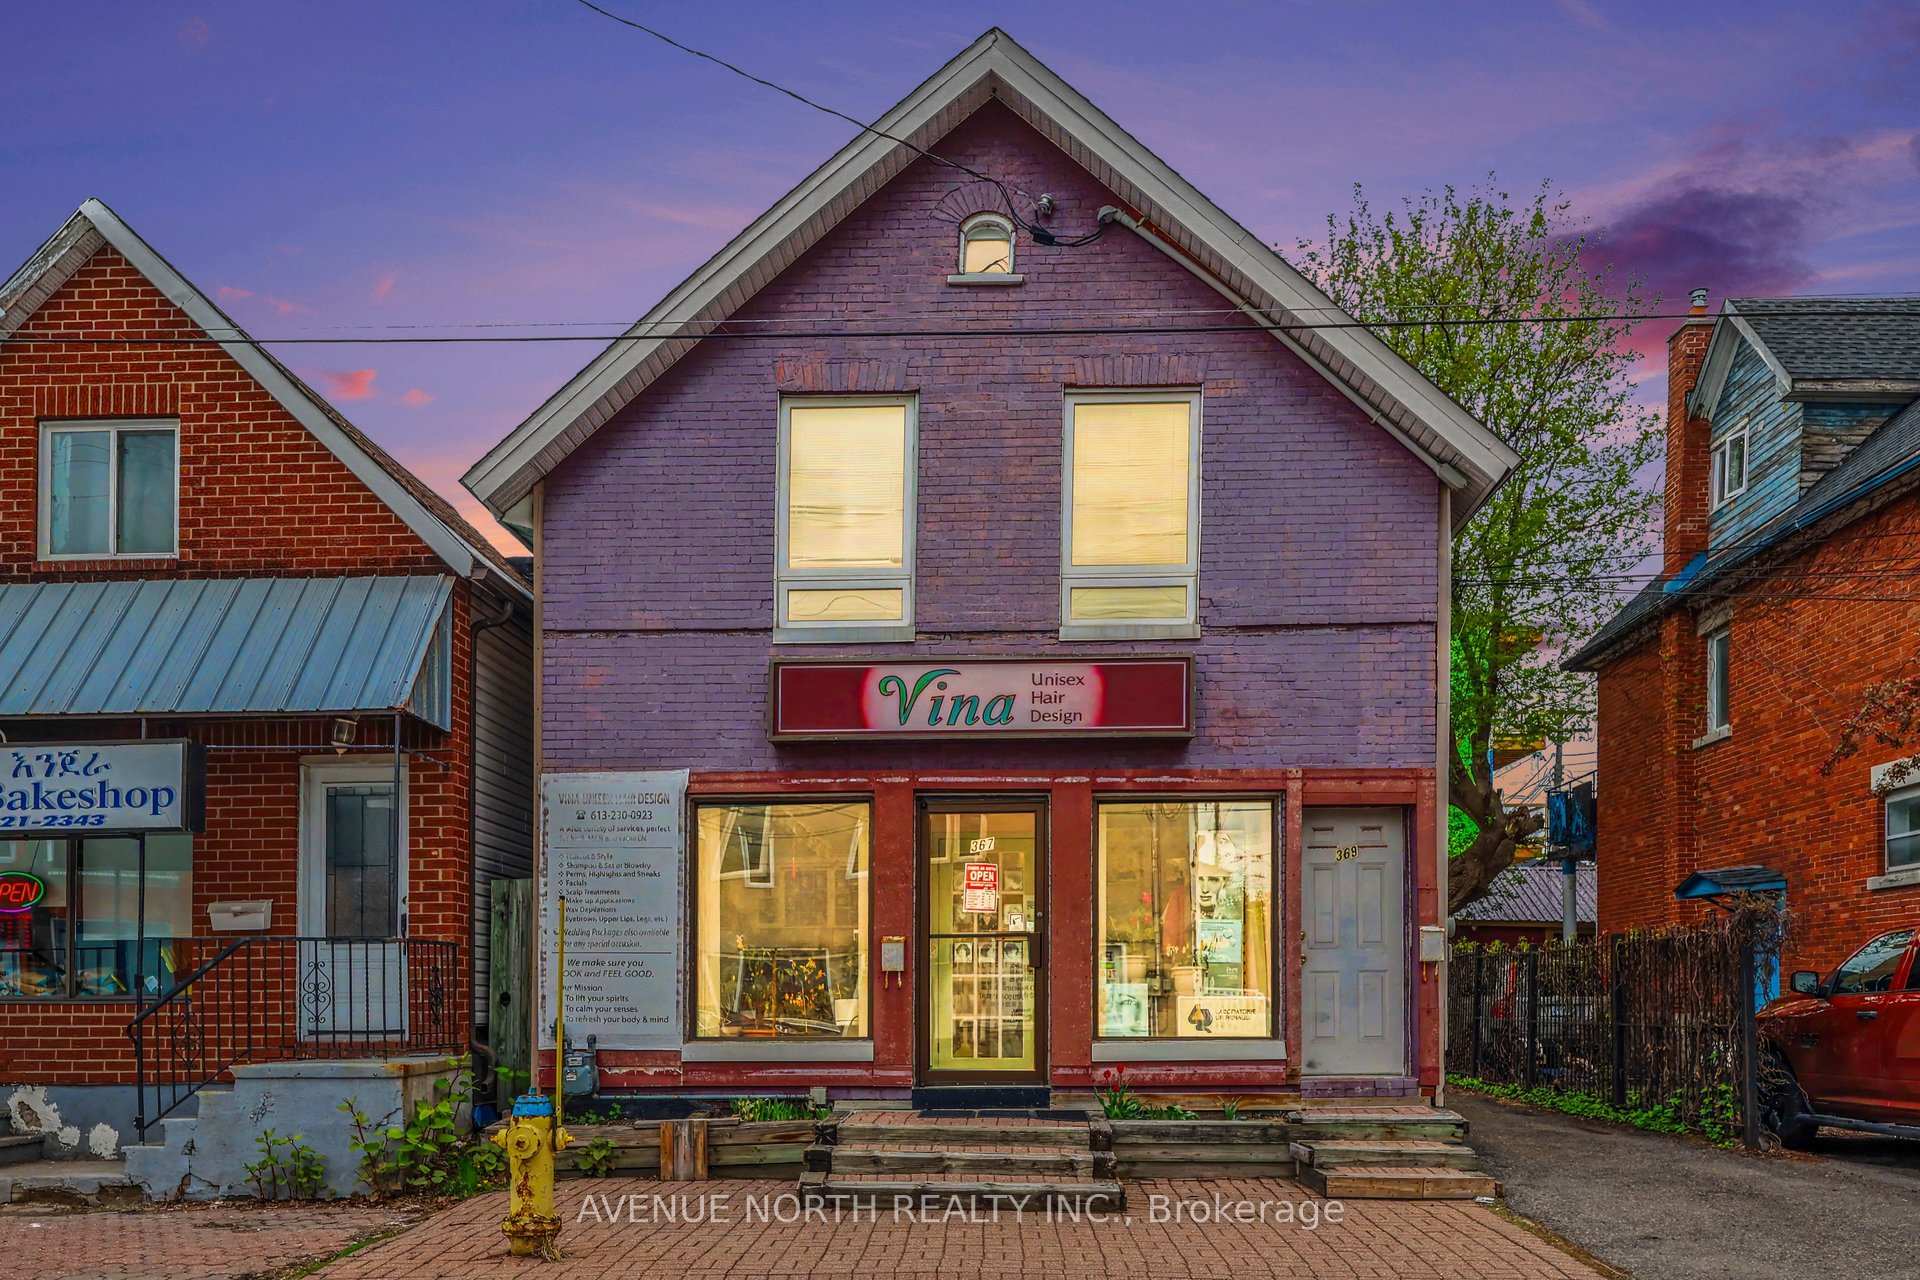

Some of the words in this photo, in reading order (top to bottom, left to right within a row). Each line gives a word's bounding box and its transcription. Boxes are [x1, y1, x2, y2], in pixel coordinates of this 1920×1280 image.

[1031, 673, 1085, 686] Unisex
[878, 668, 1017, 727] Vina
[1031, 691, 1065, 705] Hair
[1030, 710, 1083, 724] Design
[0, 779, 175, 815] akeshop
[637, 792, 670, 804] DESIGN
[591, 810, 653, 820] 613-230-0923
[646, 825, 671, 833] perfect
[971, 839, 994, 852] 367
[1336, 846, 1358, 861] 369
[970, 871, 994, 881] OPEN
[628, 960, 643, 968] you
[625, 970, 655, 978] GOOD.
[587, 995, 604, 1003] your
[606, 994, 629, 1003] spirits
[603, 1016, 620, 1024] your
[622, 1015, 641, 1024] body
[650, 1015, 669, 1023] mind
